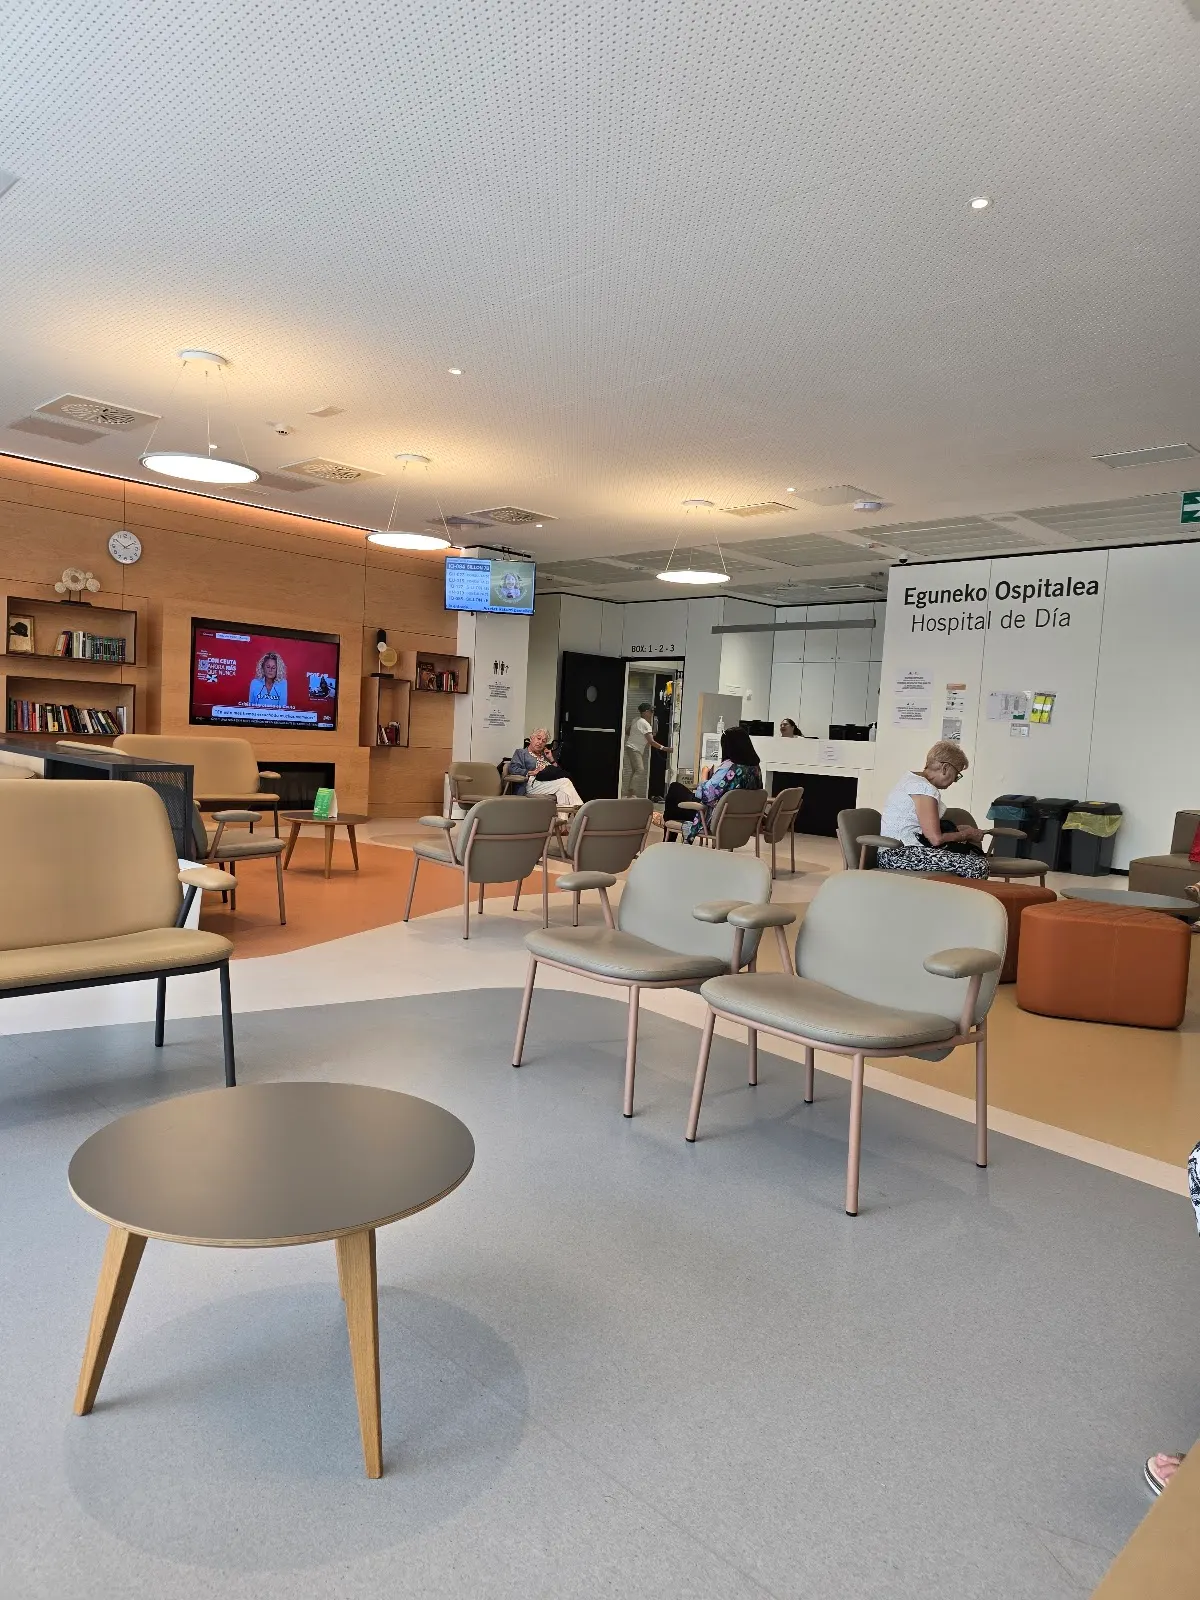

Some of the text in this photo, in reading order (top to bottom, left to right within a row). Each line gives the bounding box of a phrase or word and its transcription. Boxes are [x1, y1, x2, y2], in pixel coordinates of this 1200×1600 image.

[904, 577, 1099, 608] Eguneko Ospitalea
[911, 607, 1071, 635] Hospital de Día
[631, 645, 647, 653] BOX:
[659, 644, 664, 652] 2
[669, 644, 675, 652] 3
